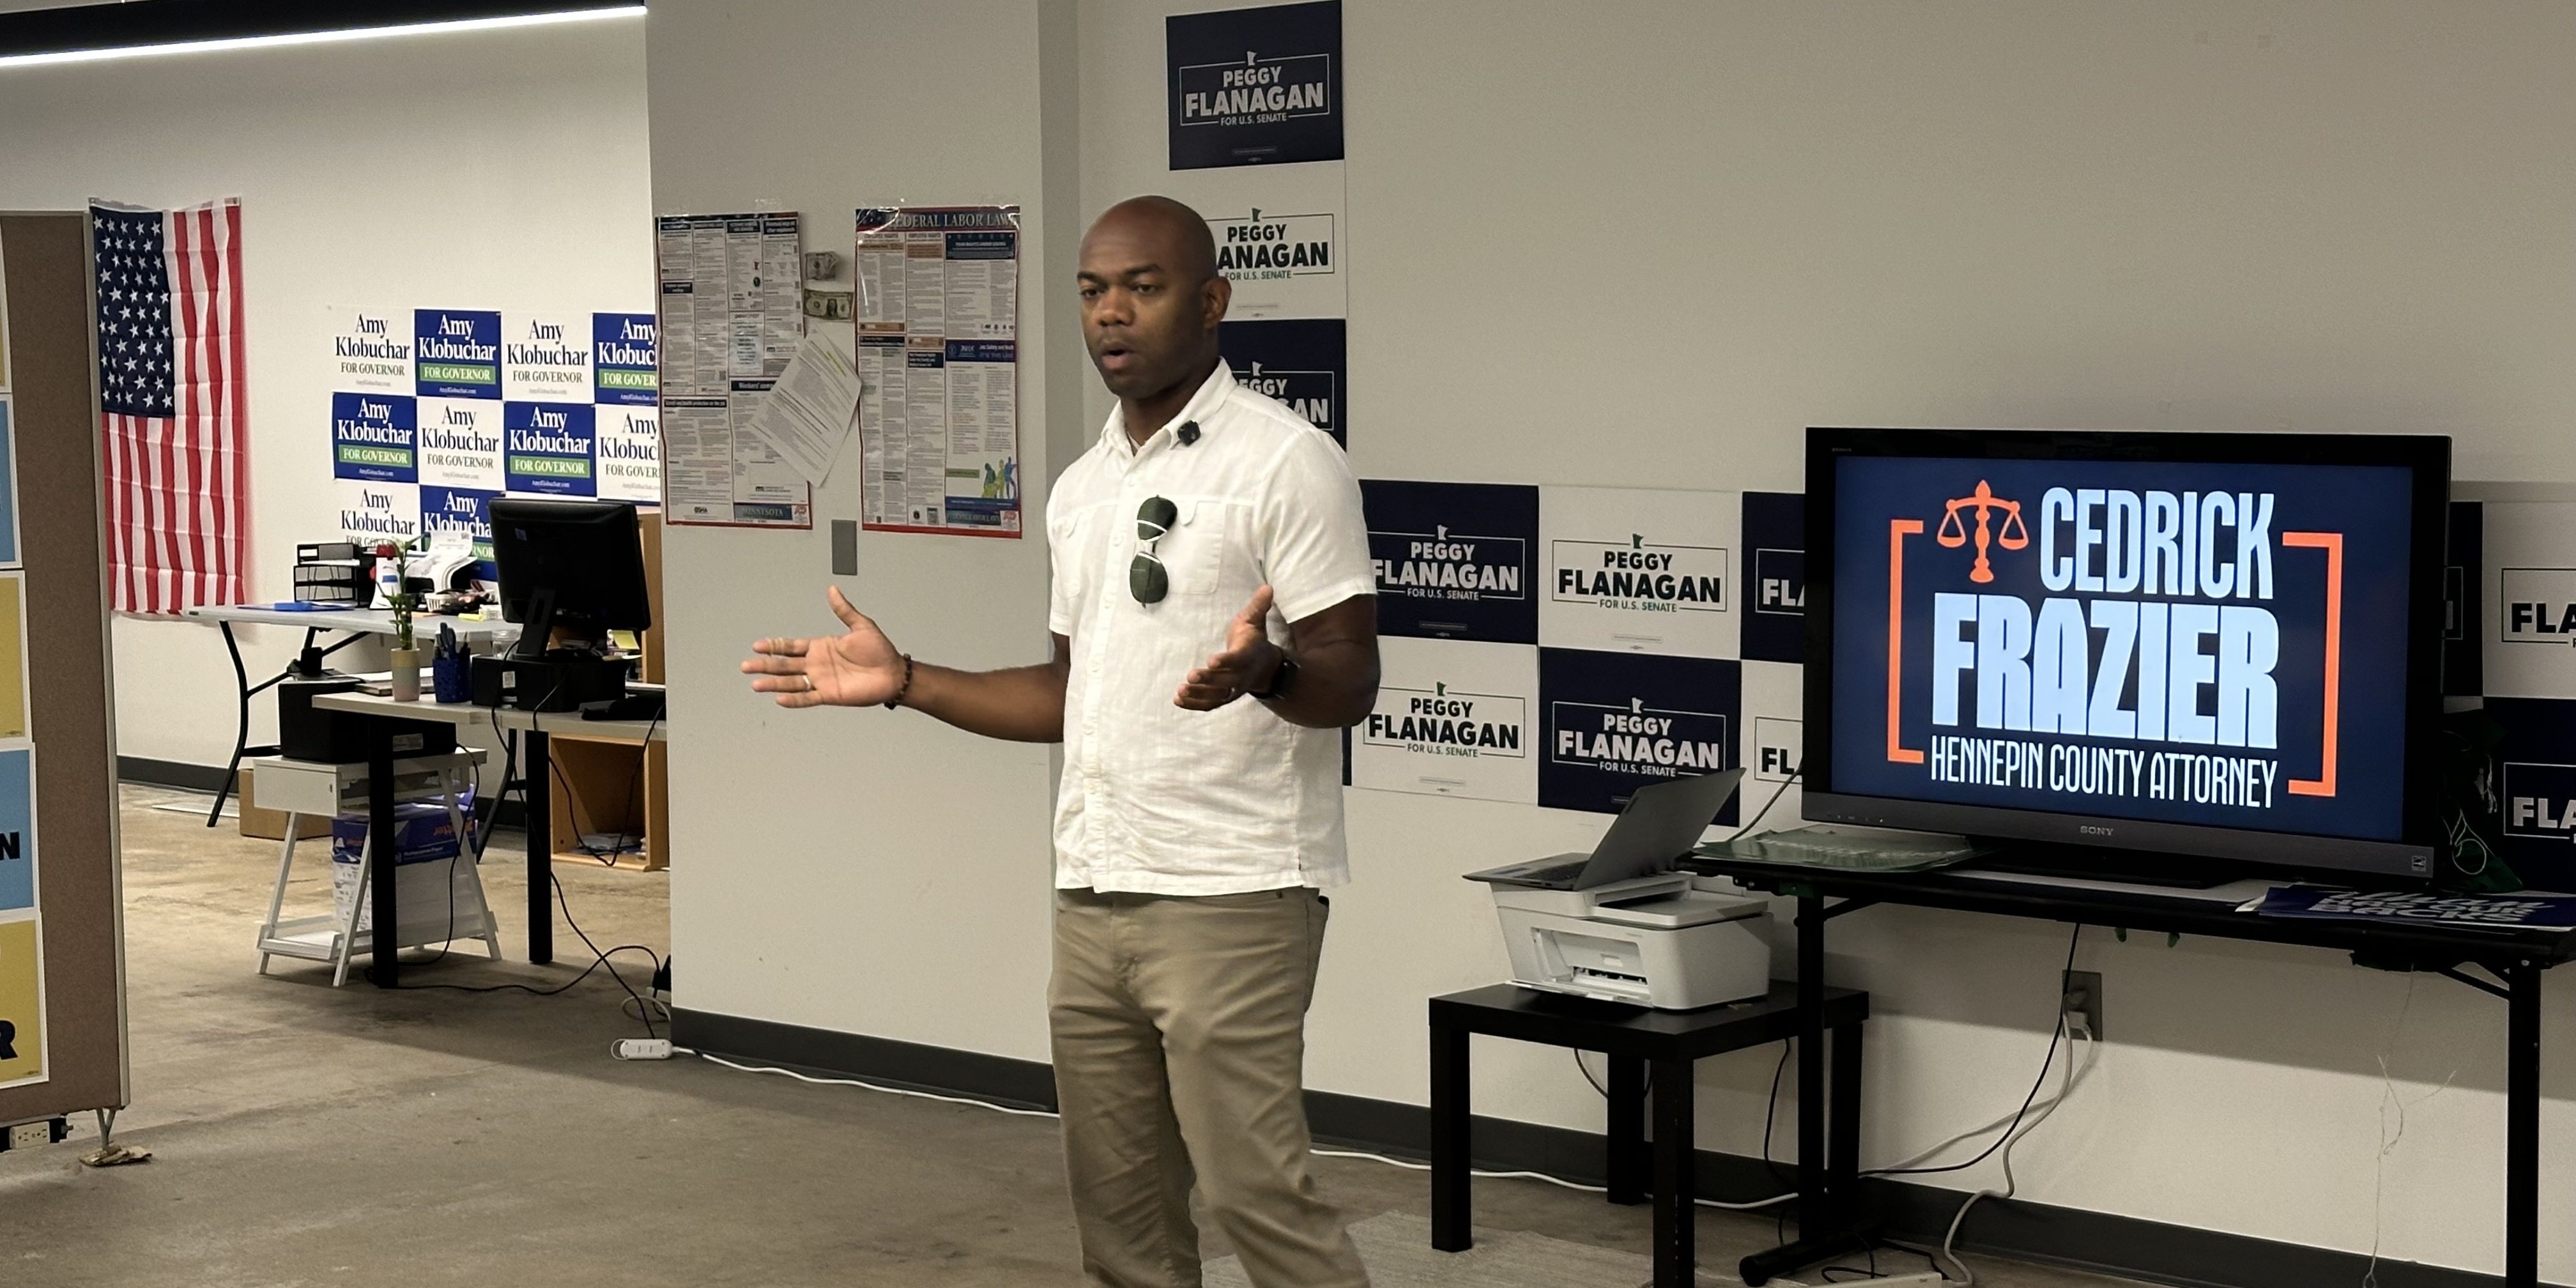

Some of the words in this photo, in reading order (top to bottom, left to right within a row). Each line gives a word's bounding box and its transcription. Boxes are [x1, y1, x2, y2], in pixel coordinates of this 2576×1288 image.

[1223, 66, 1282, 87] PEGGY
[1186, 82, 1323, 117] FLANAGAN
[1221, 118, 1236, 126] FOR
[1239, 116, 1254, 125] U.S.
[1257, 112, 1287, 123] SENATE
[945, 213, 983, 227] LABOR
[987, 213, 1013, 226] LAW
[1228, 224, 1286, 242] PEGGY
[1218, 242, 1328, 270] ANAGAN
[1225, 272, 1242, 280] FOR
[1244, 271, 1259, 279] U.S.
[1261, 270, 1291, 279] SENATE
[356, 314, 388, 339] Amy
[438, 314, 474, 340] Amy
[529, 319, 564, 344] Amy
[620, 319, 656, 344] Amy
[335, 337, 410, 360] Klobuchar
[419, 337, 496, 361] Klobuchar
[507, 344, 588, 366] Klobuchar
[599, 342, 657, 364] Klobuc
[341, 362, 358, 373] FOR
[359, 363, 404, 376] GOVERNOR
[424, 367, 443, 379] FOR
[445, 367, 490, 381] GOVERNOR
[513, 370, 531, 381] FOR
[532, 371, 582, 383] GOVERNOR
[604, 372, 623, 383] FOR
[625, 373, 657, 386] GOVER
[358, 398, 391, 420] Amy
[442, 405, 477, 427] Amy
[530, 406, 567, 433] Amy
[338, 420, 412, 445] Klobuchar
[622, 413, 658, 438] Amy
[422, 428, 499, 452] Klobuchar
[510, 429, 590, 454] Klobuchar
[600, 437, 659, 460] Klobuc
[344, 450, 360, 461] FOR
[362, 450, 407, 464] GOVERNOR
[427, 454, 445, 466] FOR
[446, 455, 493, 468] GOVERNOR
[516, 459, 534, 471] FOR
[535, 460, 585, 474] GOVERNOR
[606, 464, 624, 475] FOR
[625, 465, 658, 478] GOVER
[360, 489, 393, 512] Amy
[443, 491, 478, 515] Amy
[341, 510, 415, 535] Klobuchar
[424, 512, 492, 537] Klobucha
[1411, 542, 1475, 561] PEGGY
[2041, 486, 2274, 599] CEDRICK
[1604, 551, 1673, 571] PEGGY
[1370, 559, 1518, 591] FLANAGAN
[1559, 569, 1720, 602] FLANAGAN
[1407, 588, 1425, 597] FOR
[1428, 589, 1445, 599] U.S.
[1447, 590, 1479, 600] SENATE
[1600, 599, 1618, 608] FOR
[1621, 601, 1639, 610] U.S.
[1641, 602, 1676, 612] SENATE
[1932, 592, 2279, 749] FRAZIER
[1411, 698, 1473, 717] PEGGY
[1369, 714, 1518, 749] FLANAGAN
[1604, 714, 1672, 735] PEGGY
[1407, 744, 1425, 753] FOR
[1427, 746, 1443, 754] U.S.
[1445, 747, 1478, 758] SENATE
[1559, 730, 1719, 769] FLANAGAN
[1600, 762, 1618, 771] FOR
[1621, 763, 1639, 774] U.S.
[1641, 765, 1676, 777] SENATE
[1931, 735, 2043, 790] HENNEPIN
[2050, 746, 2143, 799] COUNTY
[2150, 753, 2278, 809] ATTORNEY
[2080, 825, 2114, 836] SONY
